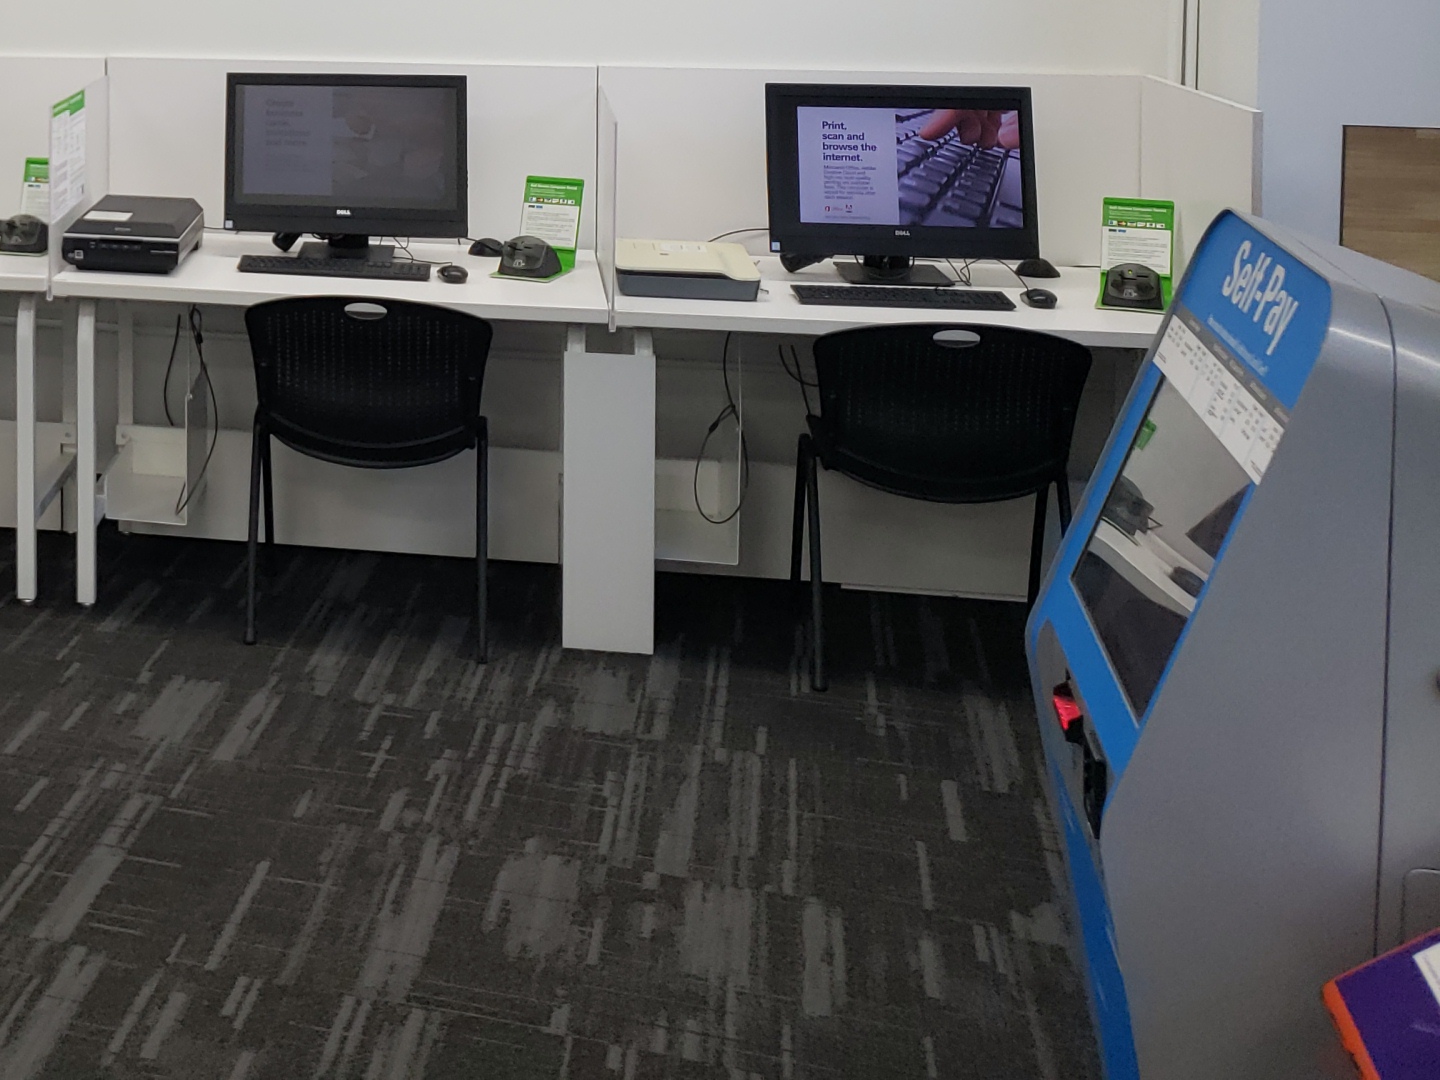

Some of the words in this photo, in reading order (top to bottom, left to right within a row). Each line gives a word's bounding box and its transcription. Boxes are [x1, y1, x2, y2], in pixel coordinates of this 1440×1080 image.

[822, 121, 847, 130] Print,
[847, 132, 865, 140] and
[823, 142, 859, 151] browse
[860, 143, 877, 151] the
[823, 153, 863, 161] internet.
[1222, 240, 1299, 356] Self-Pay
